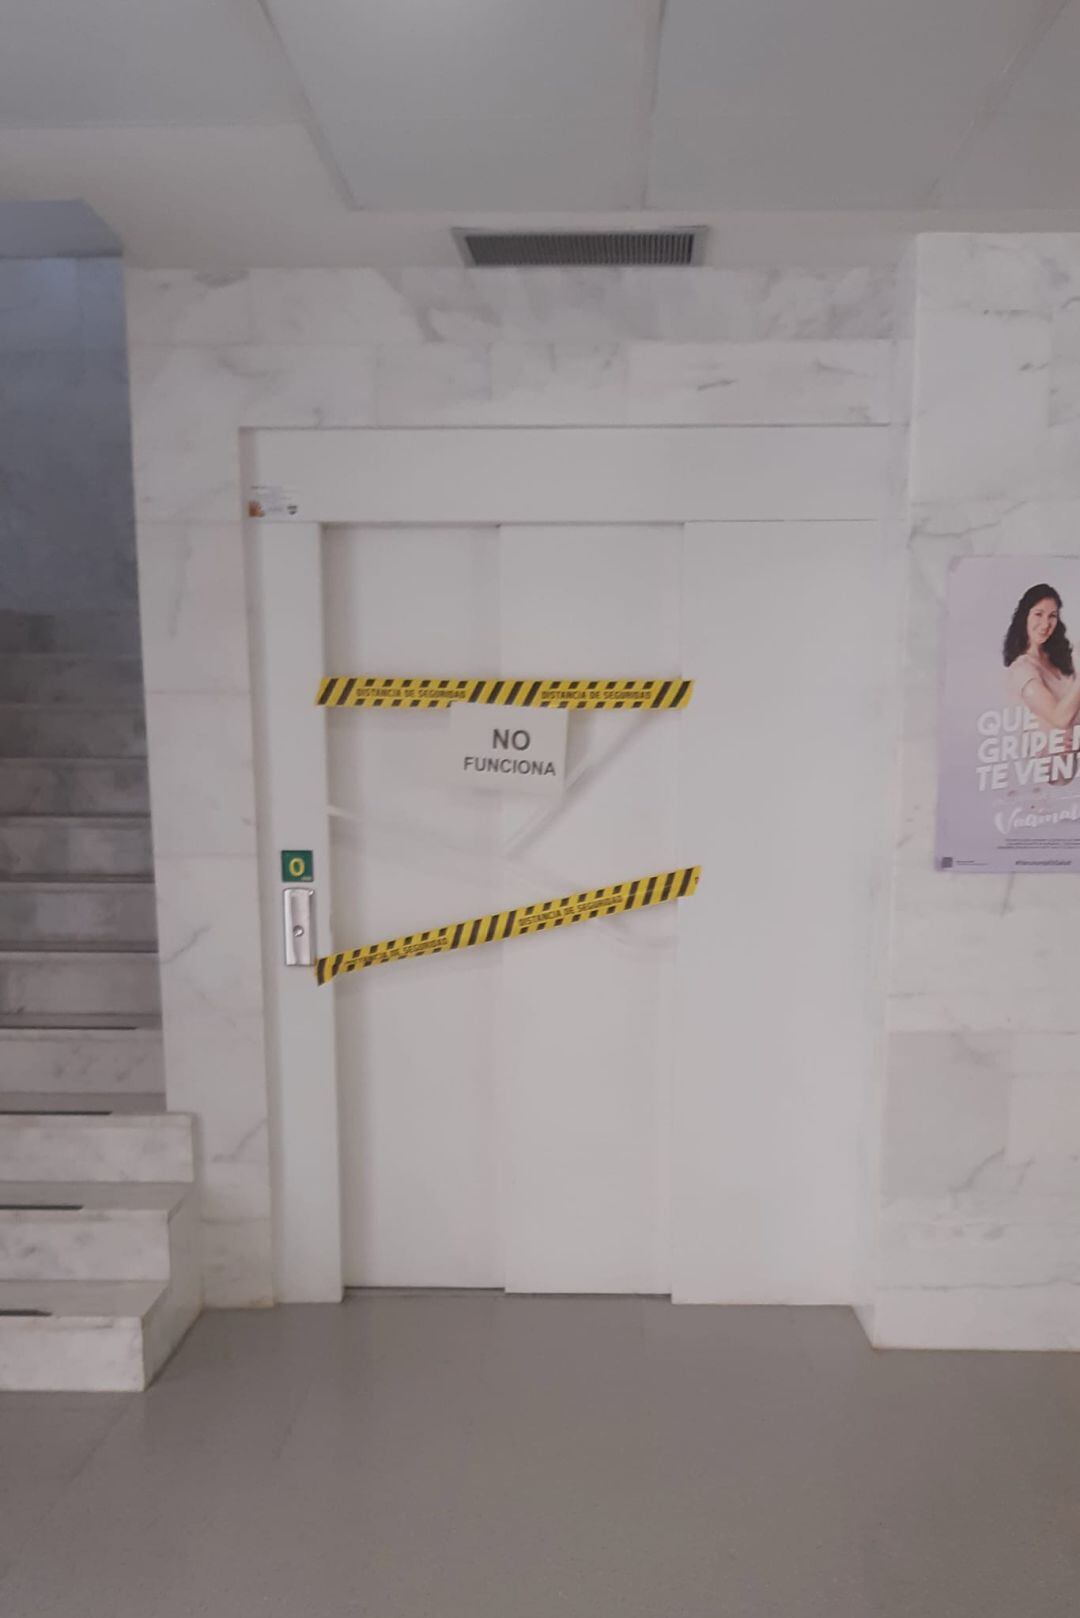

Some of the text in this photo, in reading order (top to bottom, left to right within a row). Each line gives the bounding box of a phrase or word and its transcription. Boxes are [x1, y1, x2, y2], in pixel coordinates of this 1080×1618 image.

[355, 688, 466, 699] DISTANCIA DE SEGURIDAD
[541, 691, 652, 700] DISTANCIA DE SEGURIDAD
[977, 706, 1040, 737] QUE
[492, 728, 531, 751] NO
[978, 729, 1067, 764] GRIPE
[463, 756, 557, 777] FUNCIONA
[975, 752, 1080, 792] TE VEN
[518, 895, 624, 927] DISTANCIA DE SEGURIDAD
[402, 936, 449, 955] SEGURIDAD
